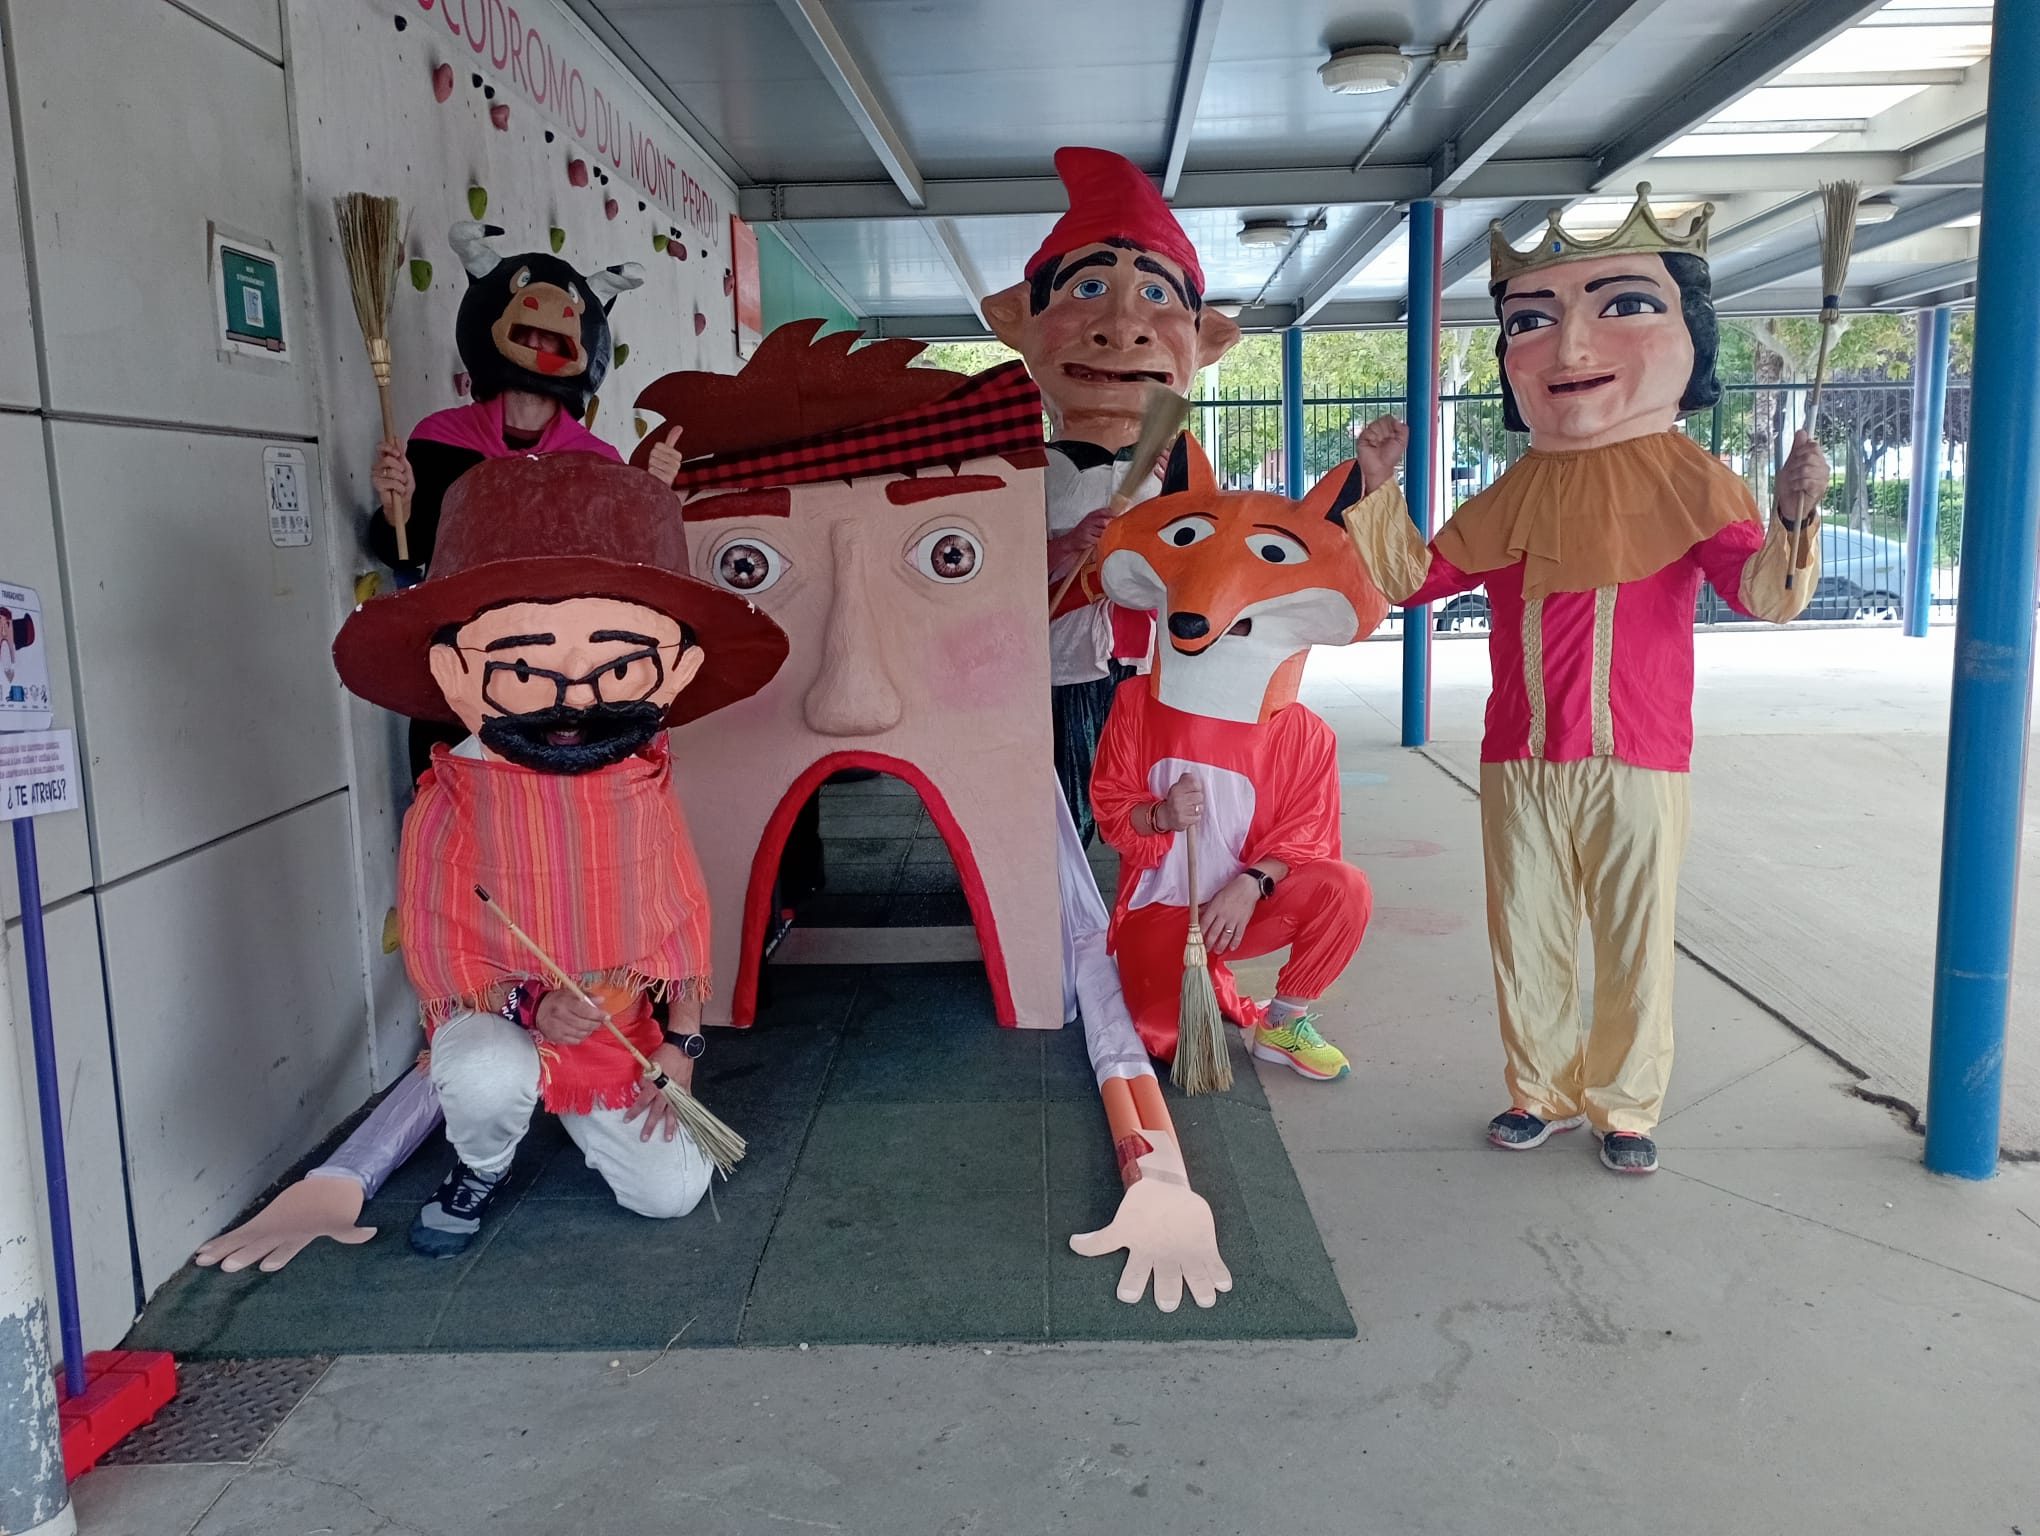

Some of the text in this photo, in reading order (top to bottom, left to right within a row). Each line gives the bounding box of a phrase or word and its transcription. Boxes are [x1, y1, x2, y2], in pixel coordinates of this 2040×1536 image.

[418, 0, 719, 247] ODROMO DU MONT PERDU
[31, 778, 66, 804] ATREVES?
